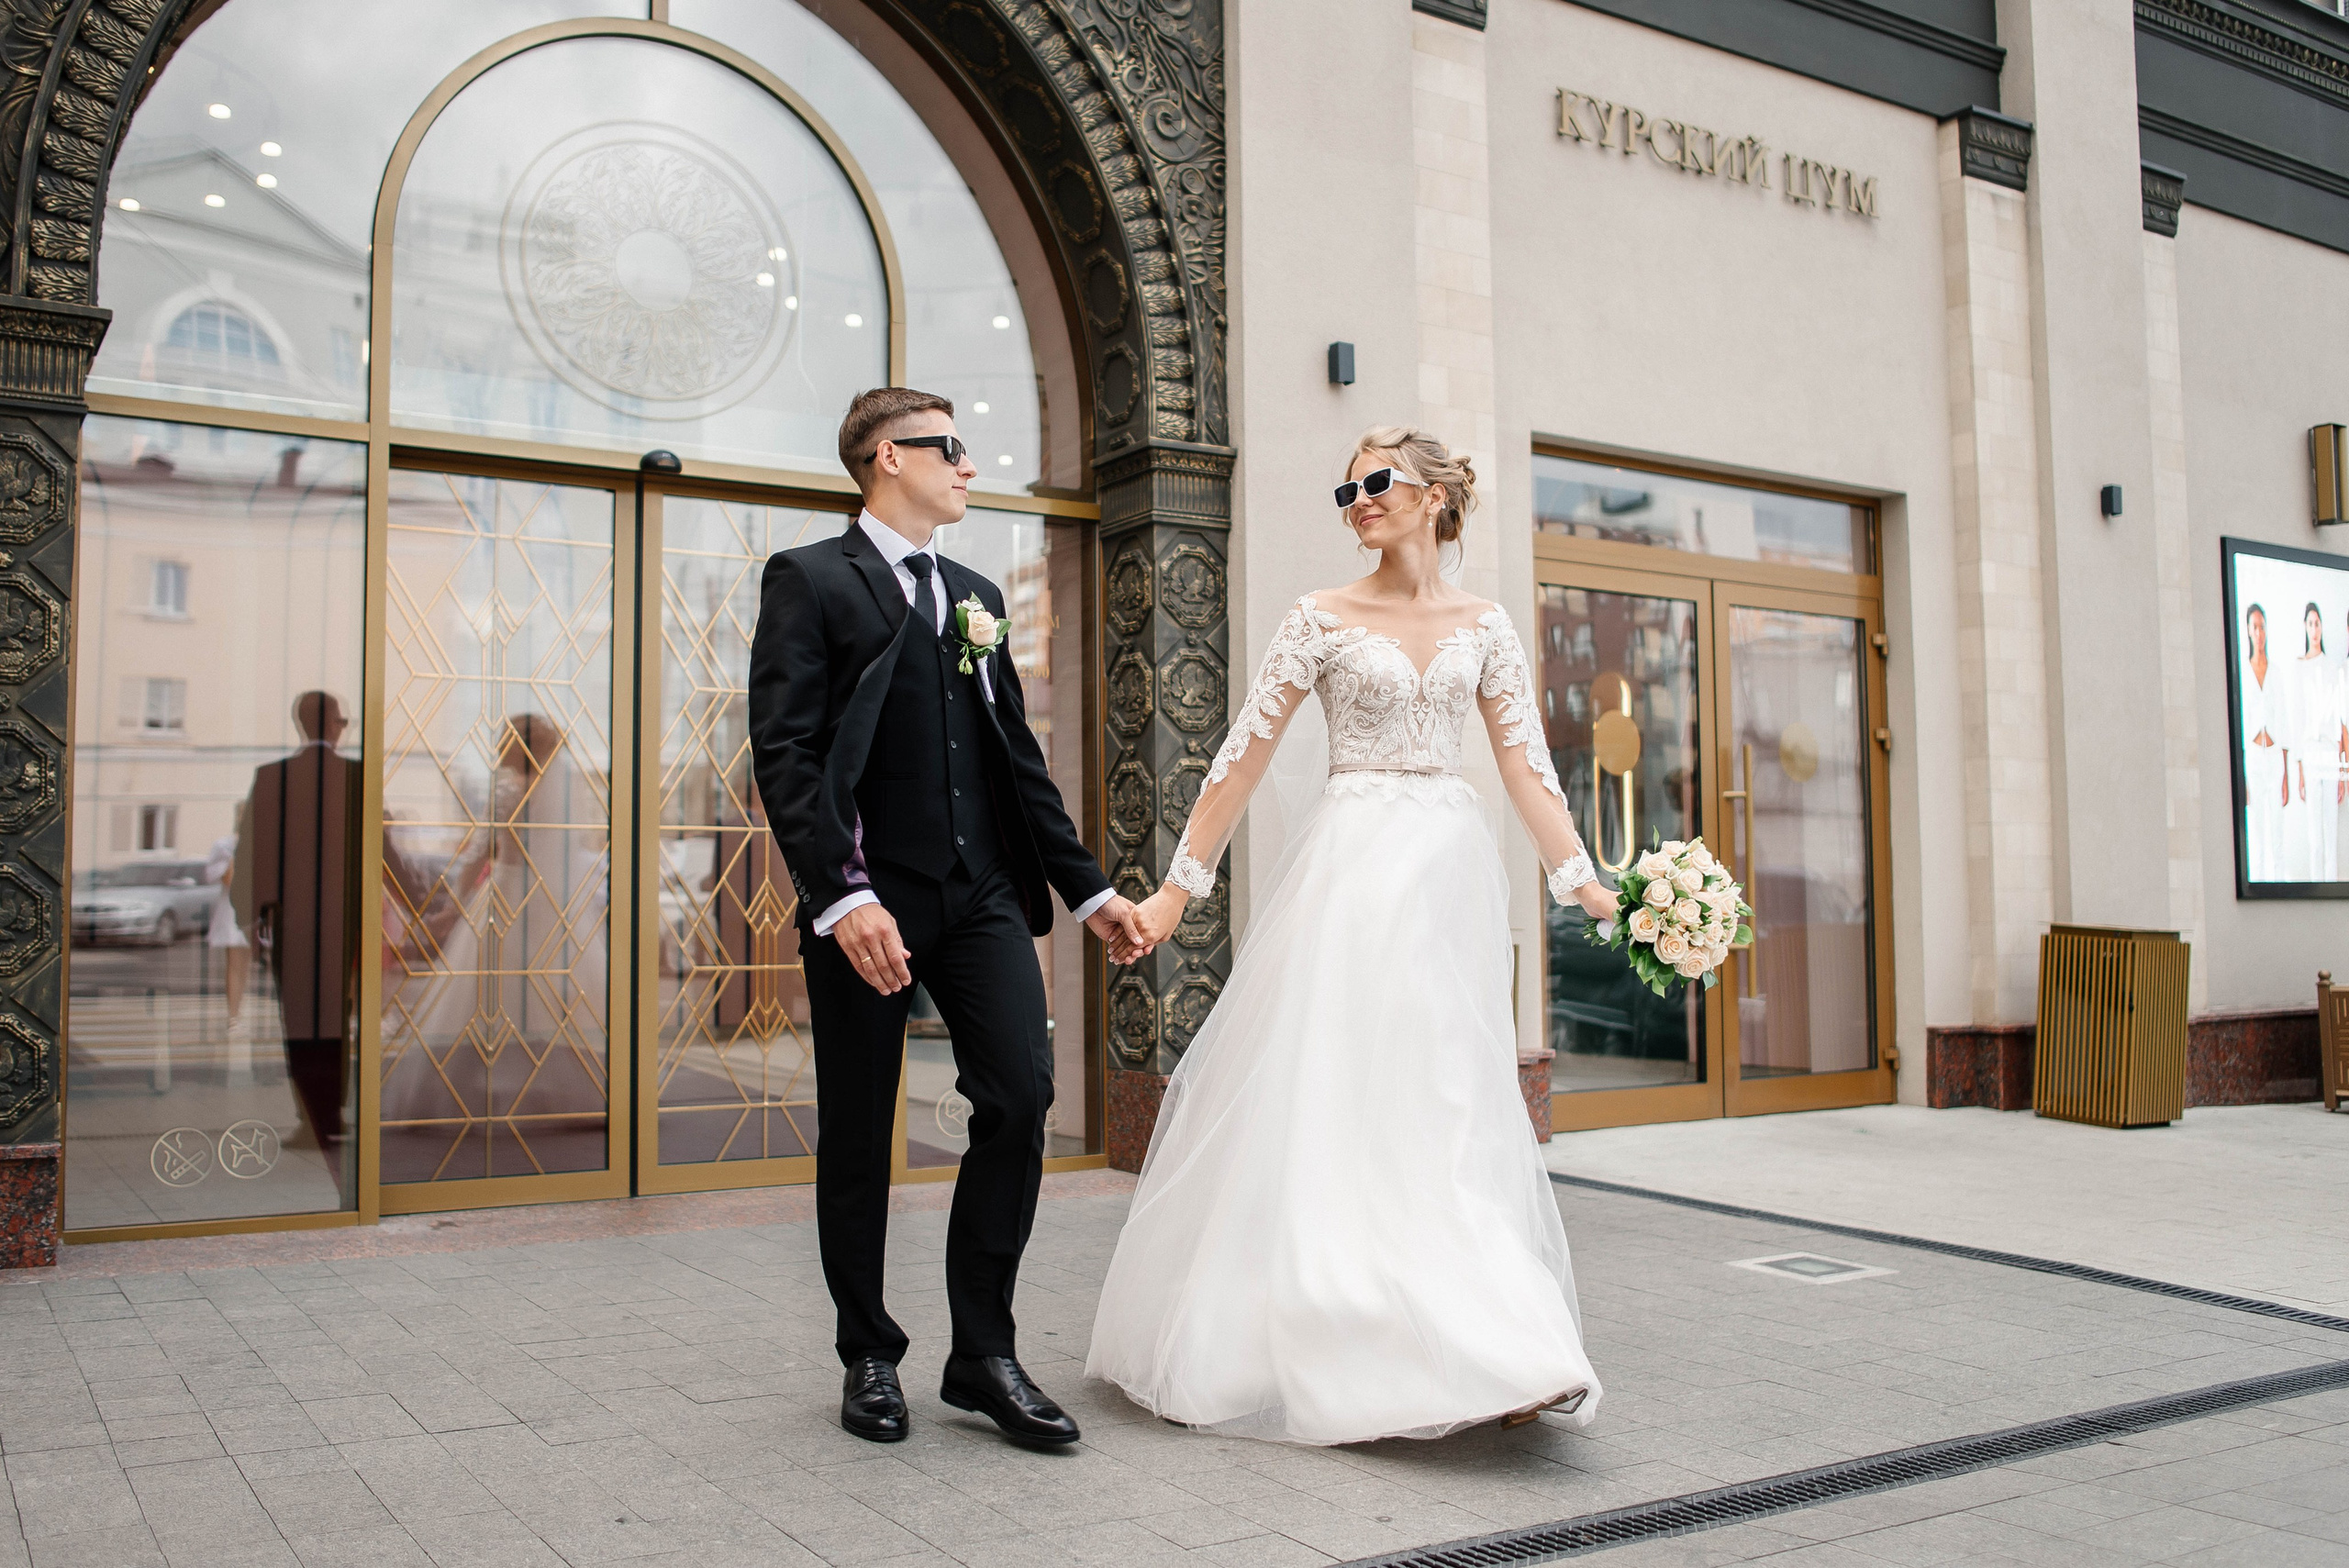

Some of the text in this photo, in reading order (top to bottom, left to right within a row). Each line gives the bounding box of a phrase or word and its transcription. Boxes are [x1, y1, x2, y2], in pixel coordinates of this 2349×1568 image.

[1556, 86, 1879, 219] КУРСКИЙ ЦУМ
[1016, 663, 1050, 678] 2:00
